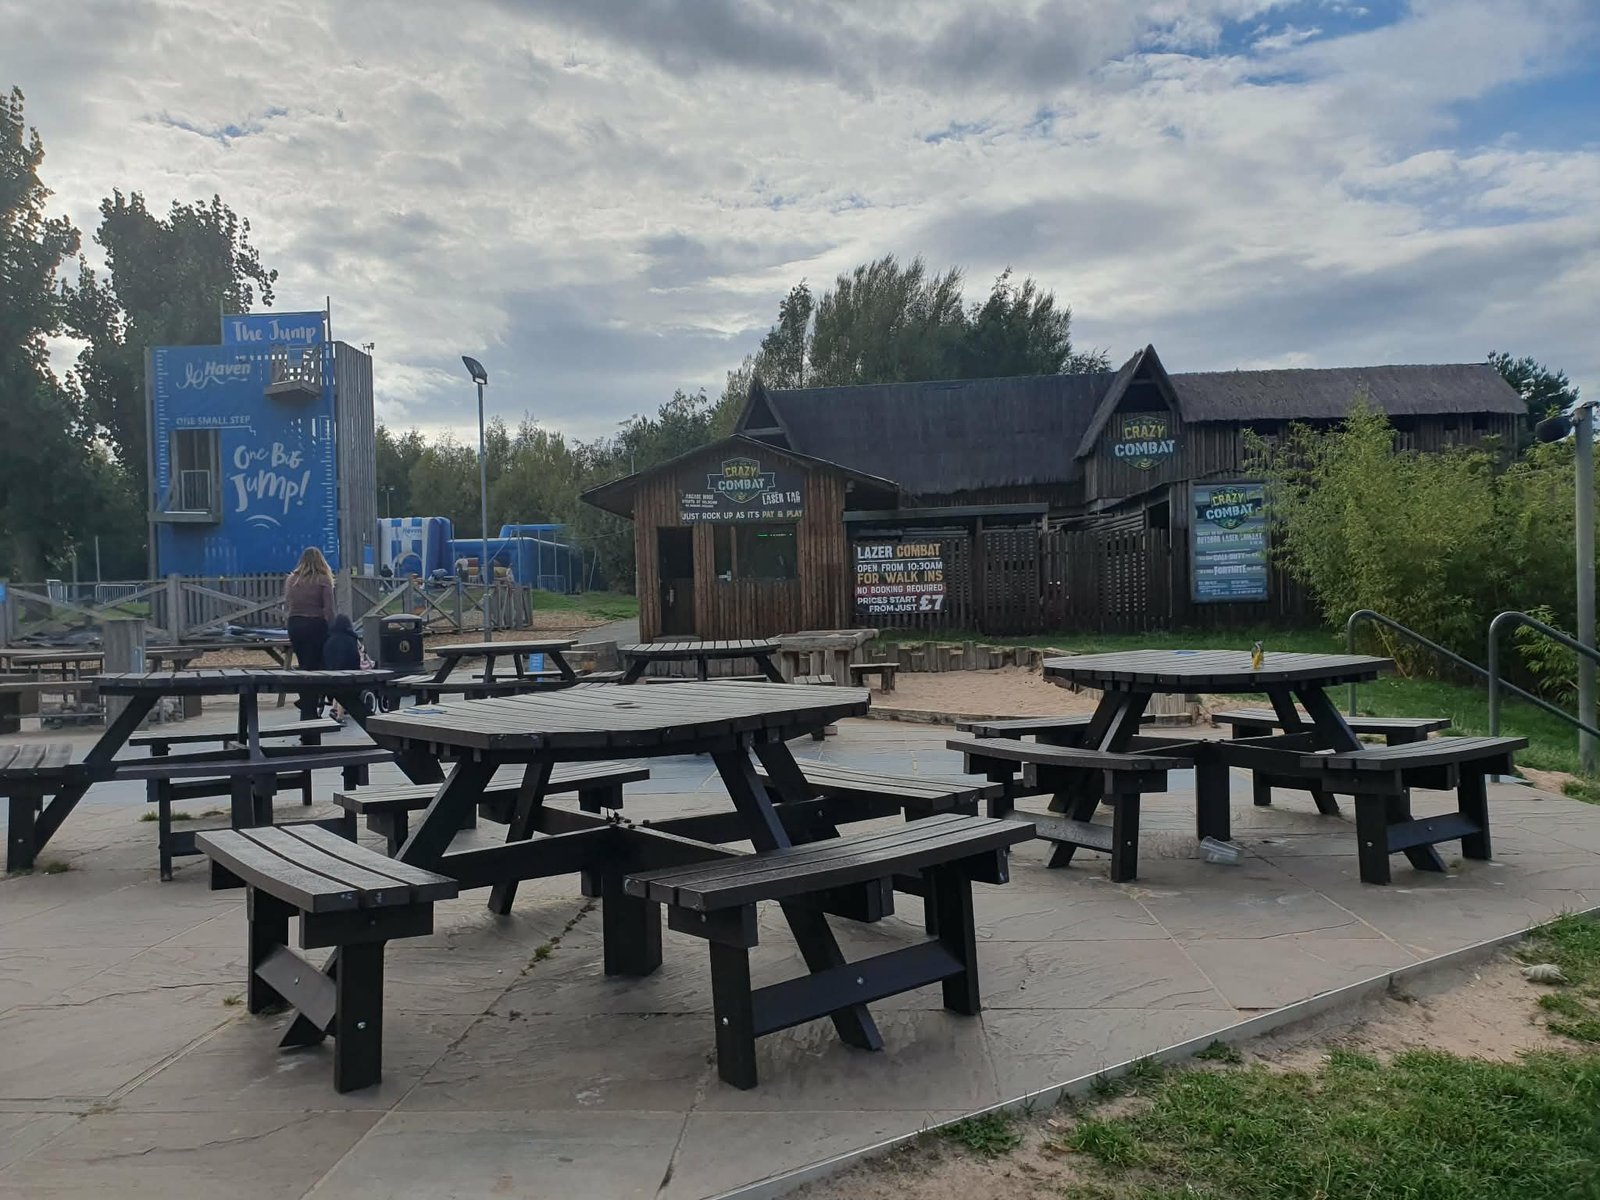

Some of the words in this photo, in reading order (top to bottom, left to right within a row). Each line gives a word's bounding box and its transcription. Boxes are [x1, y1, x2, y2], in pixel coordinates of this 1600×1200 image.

[232, 321, 263, 342] The
[268, 319, 317, 344] Jump
[205, 361, 250, 376] Haven
[176, 417, 196, 426] ONE
[198, 416, 228, 425] SMALL
[229, 415, 250, 424] STEP
[1124, 424, 1165, 440] CRAZY
[1114, 440, 1175, 457] COMBAT
[233, 445, 270, 470] One
[725, 465, 758, 478] CRAZY
[718, 478, 765, 491] COMBAT
[762, 492, 785, 506] LASER
[786, 490, 801, 504] TAG
[1212, 493, 1245, 506] CRAZY
[682, 512, 700, 520] JUST
[702, 511, 721, 520] ROCK
[723, 511, 734, 519] UP
[736, 511, 745, 519] AS
[762, 510, 775, 519] PAY
[786, 509, 803, 518] PLAY
[1206, 503, 1253, 519] COMBAT
[857, 545, 893, 559] LAZER
[896, 543, 942, 557] COMBAT
[857, 564, 878, 573] OPEN
[881, 562, 904, 572] FROM
[907, 561, 943, 571] 10:30AM
[857, 572, 879, 585] FOR
[885, 571, 918, 583] WALK
[924, 569, 944, 582] INS
[857, 586, 868, 595] NO
[870, 585, 903, 594] BOOKING
[906, 583, 943, 593] REQUIRED
[889, 595, 917, 603] START
[919, 594, 944, 611] £7
[869, 604, 894, 613] FROM
[895, 604, 917, 612] JUST
